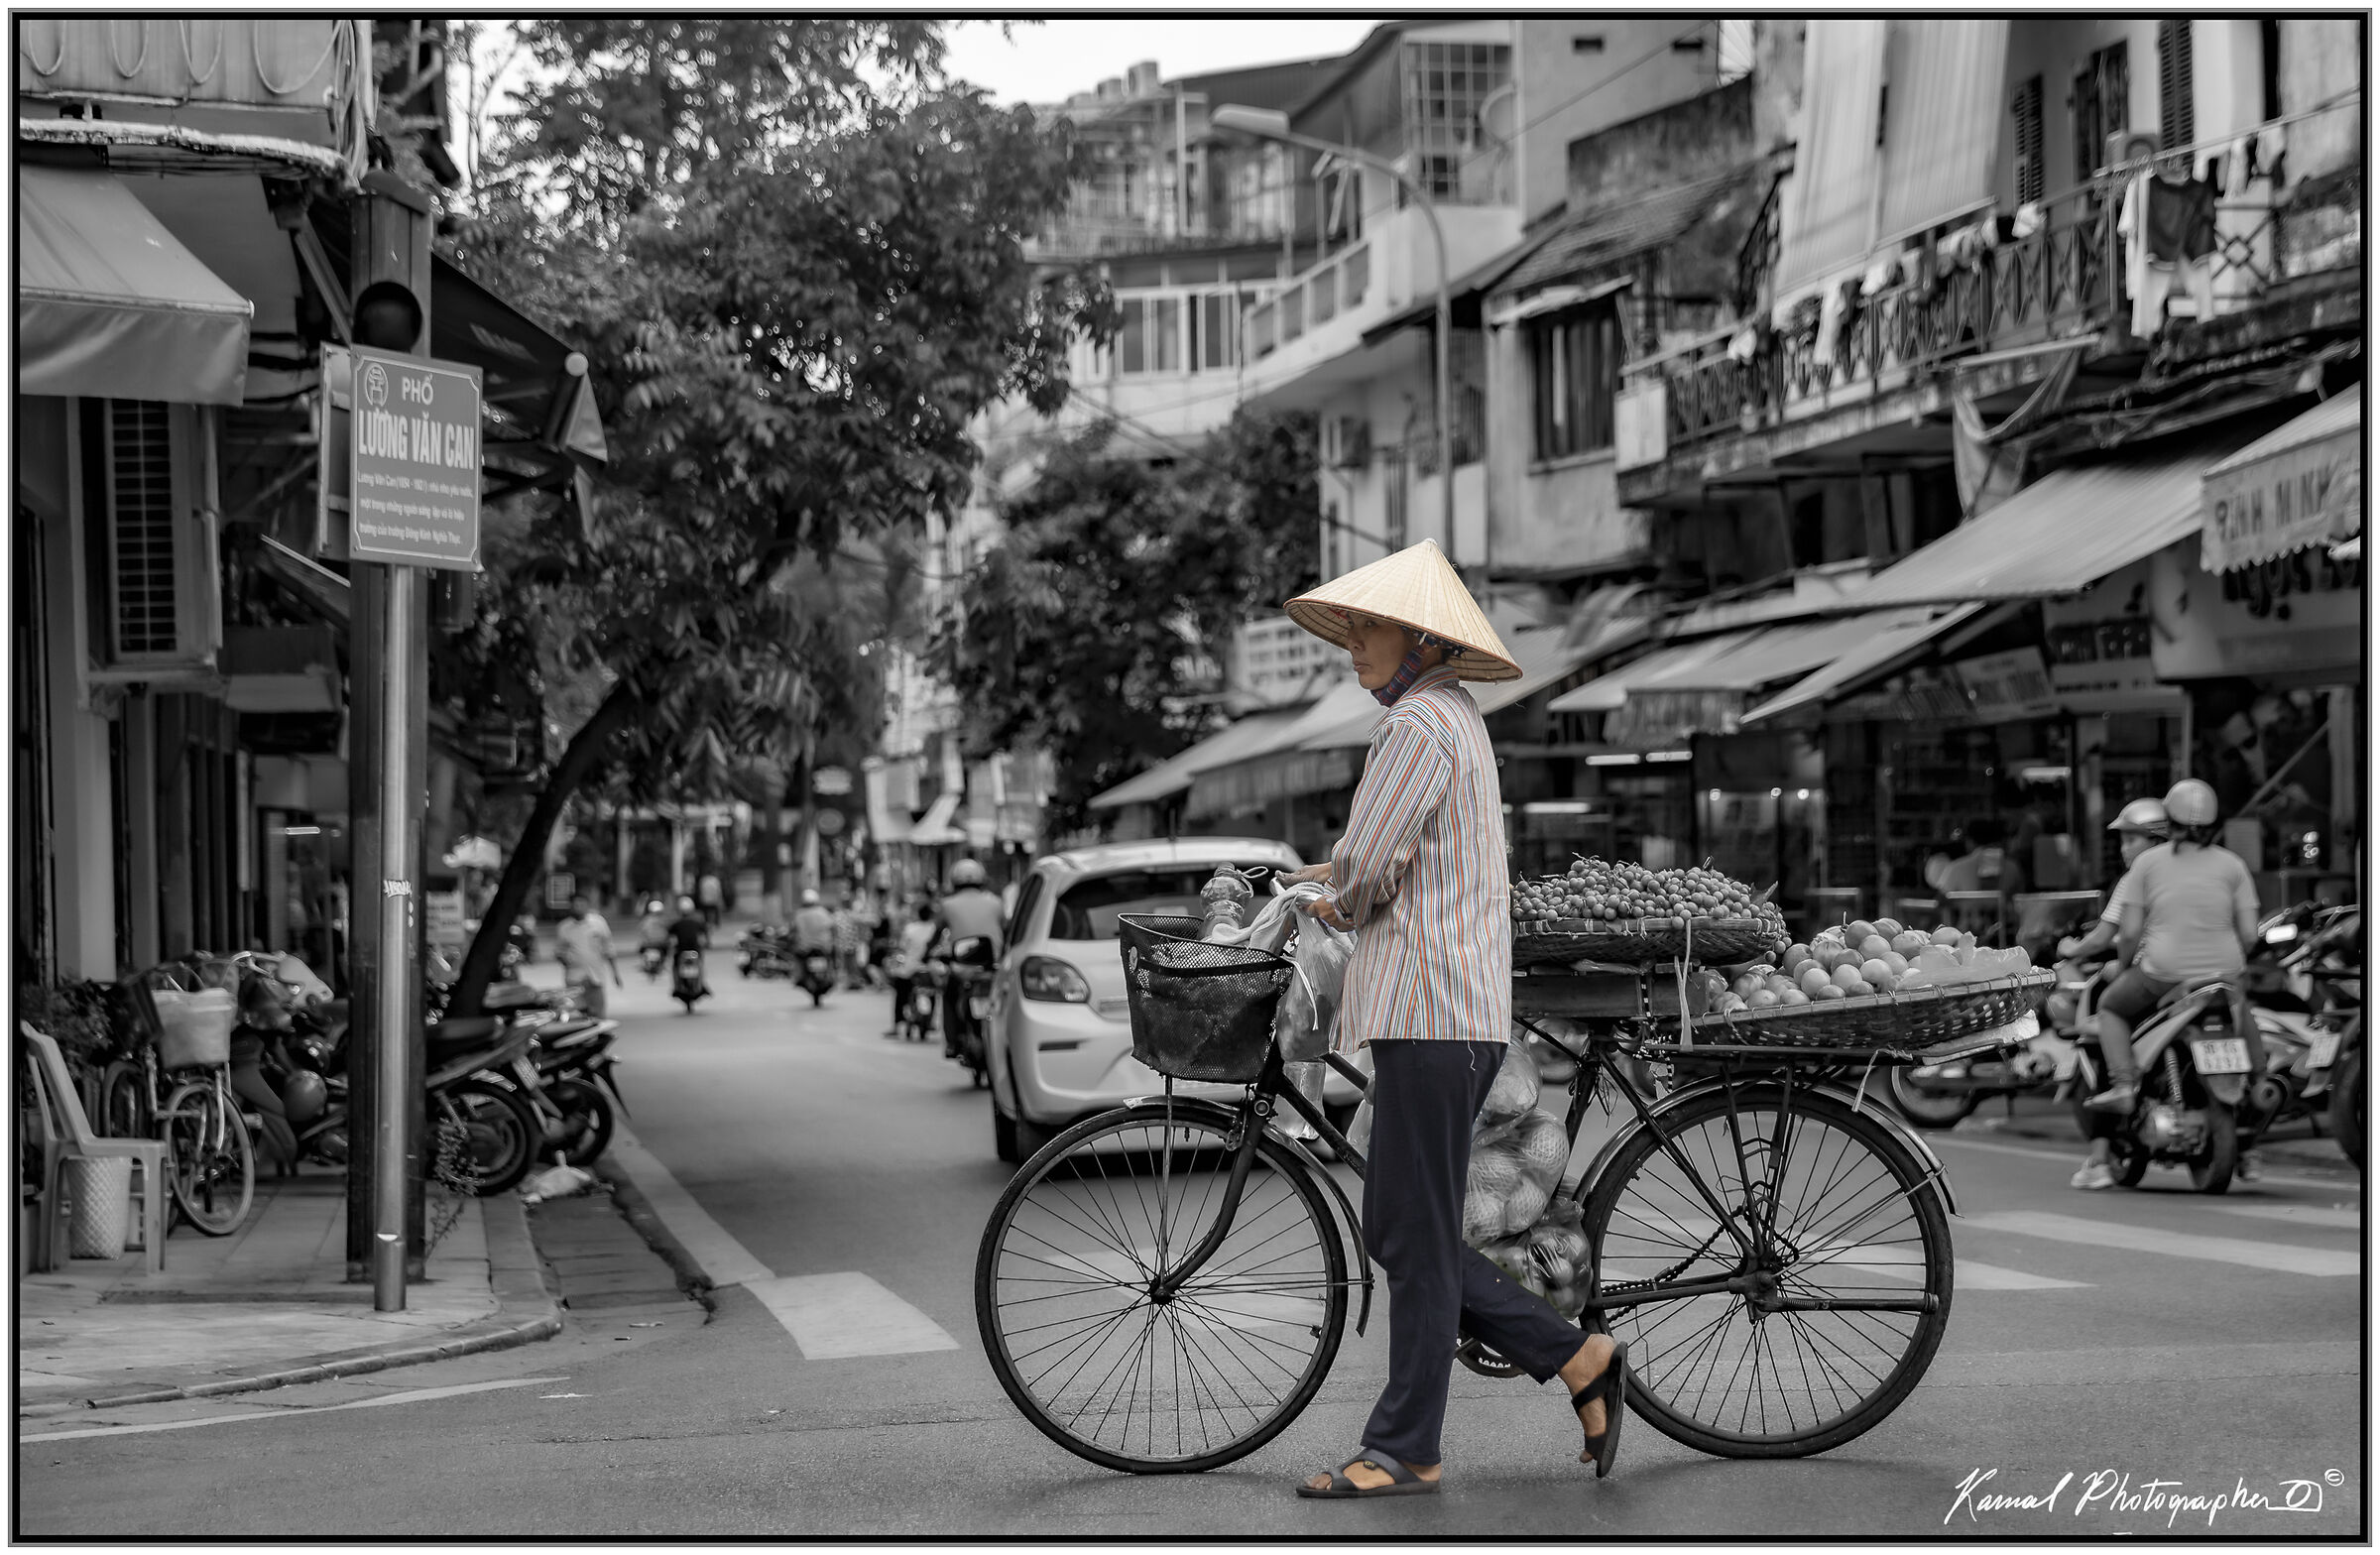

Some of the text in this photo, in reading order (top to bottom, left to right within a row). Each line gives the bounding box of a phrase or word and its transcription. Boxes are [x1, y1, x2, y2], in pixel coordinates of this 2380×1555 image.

[402, 372, 433, 406] PHỐ
[358, 407, 474, 470] LƯƠNG VĂN CAN
